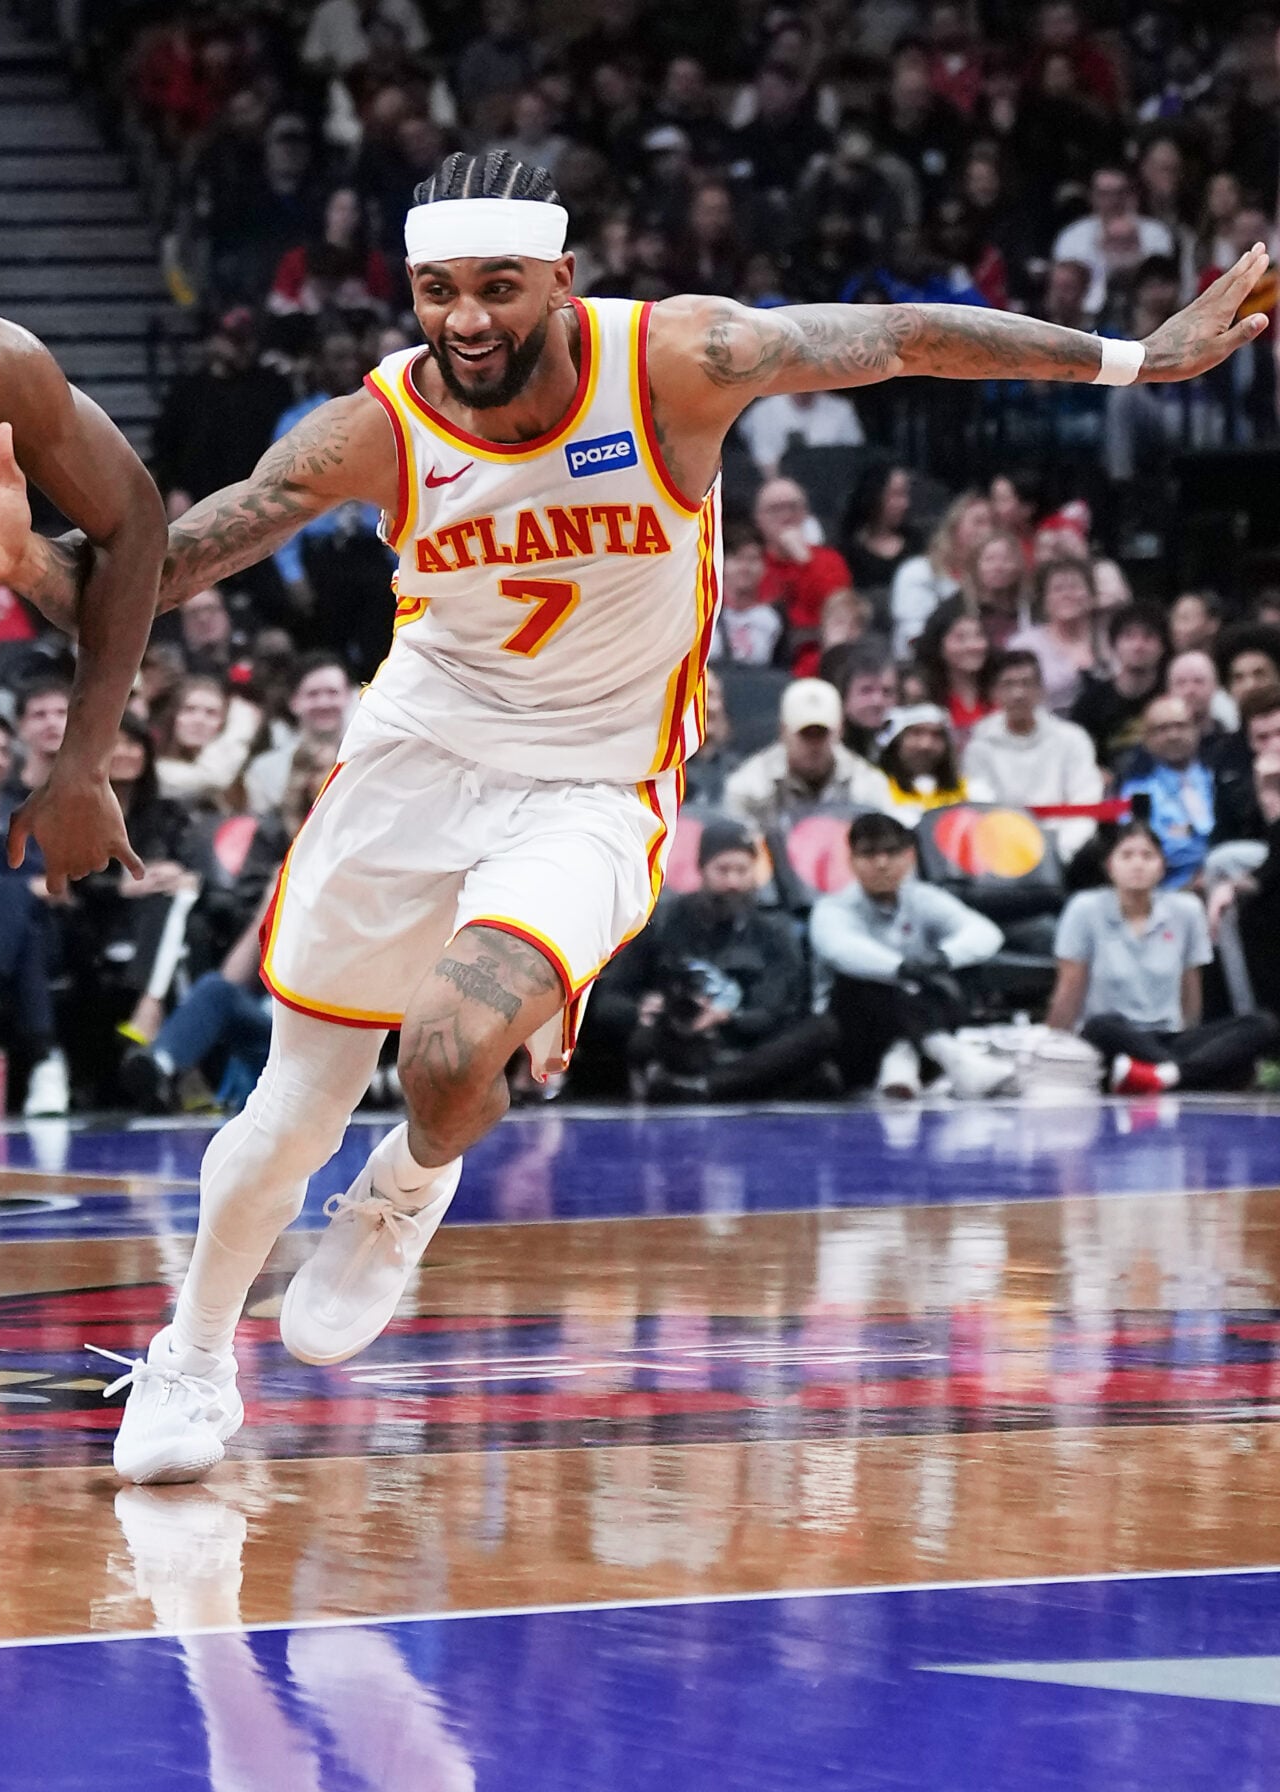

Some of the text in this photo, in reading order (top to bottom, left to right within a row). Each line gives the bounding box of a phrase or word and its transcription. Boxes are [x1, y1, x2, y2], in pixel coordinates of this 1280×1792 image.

[570, 441, 631, 470] paze
[415, 503, 671, 574] ATLANTA
[498, 578, 581, 658] 7
